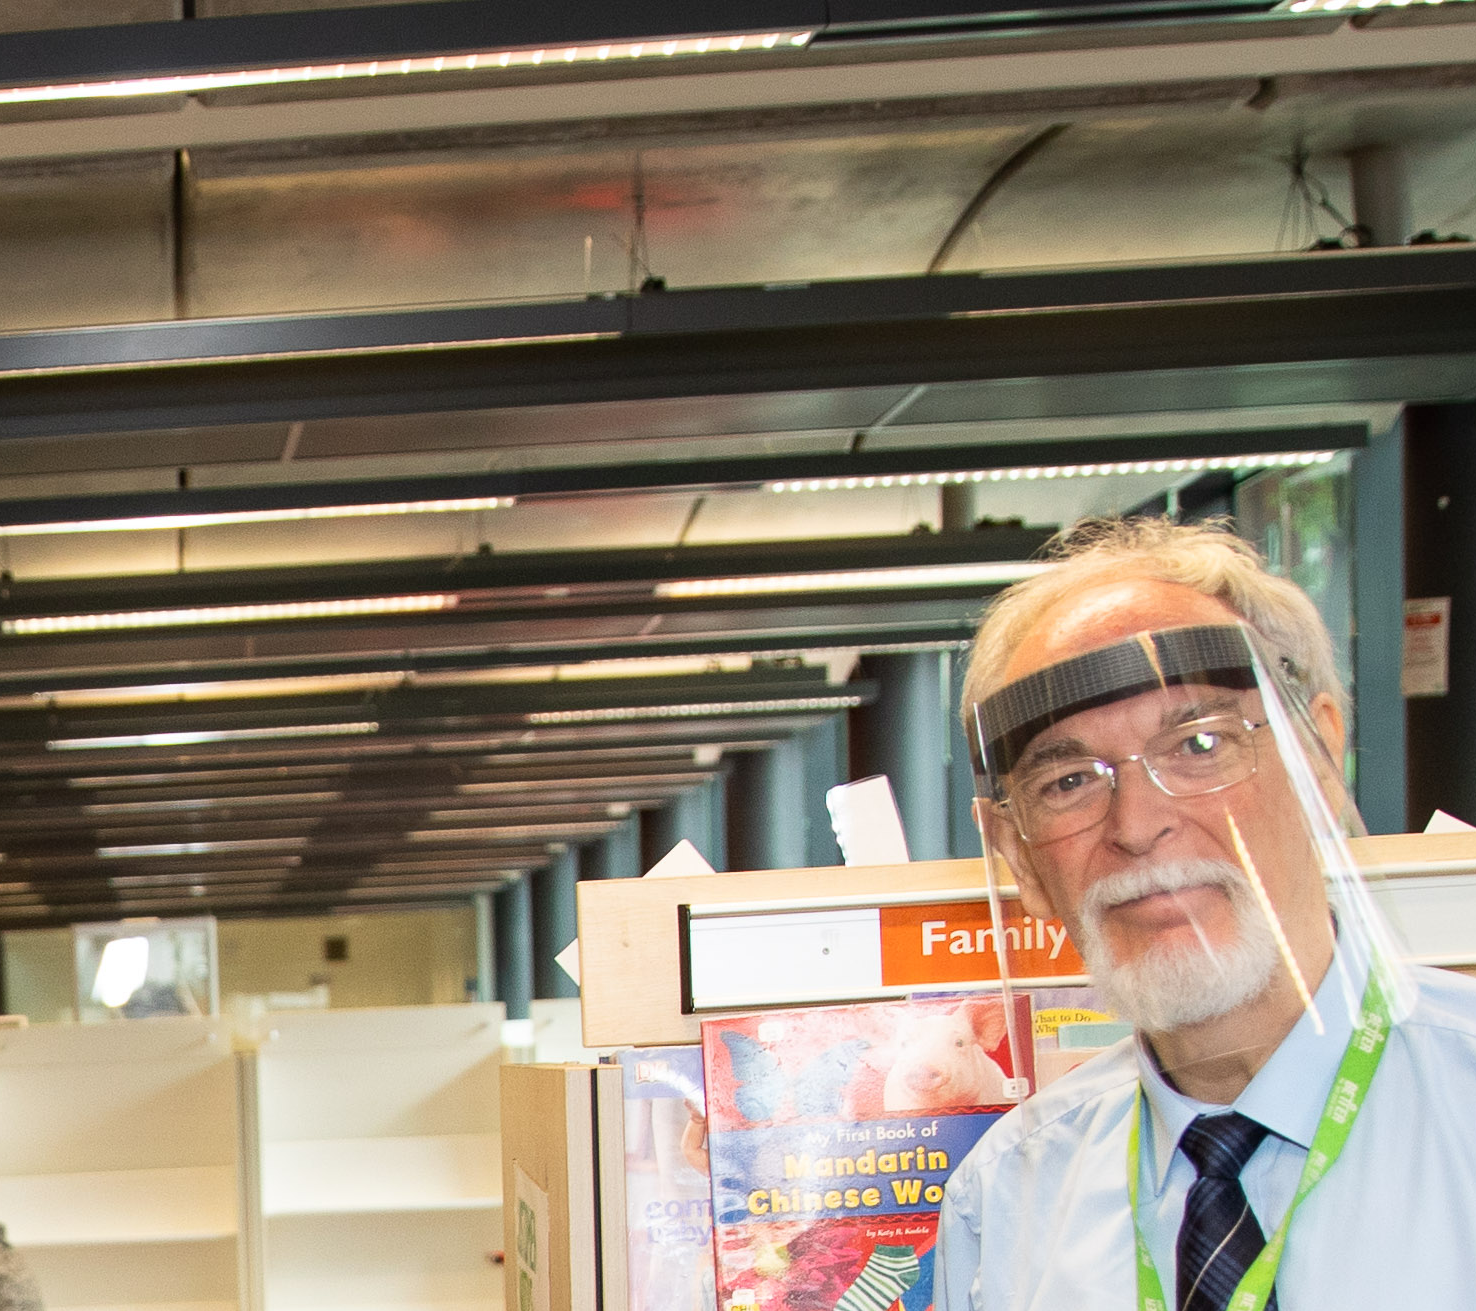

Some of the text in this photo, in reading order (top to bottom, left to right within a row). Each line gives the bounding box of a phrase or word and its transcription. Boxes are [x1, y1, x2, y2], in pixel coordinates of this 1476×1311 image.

[922, 916, 1069, 959] Family
[837, 1125, 871, 1142] First
[876, 1122, 917, 1142] Book
[921, 1120, 938, 1138] of
[783, 1145, 949, 1181] Mandarin
